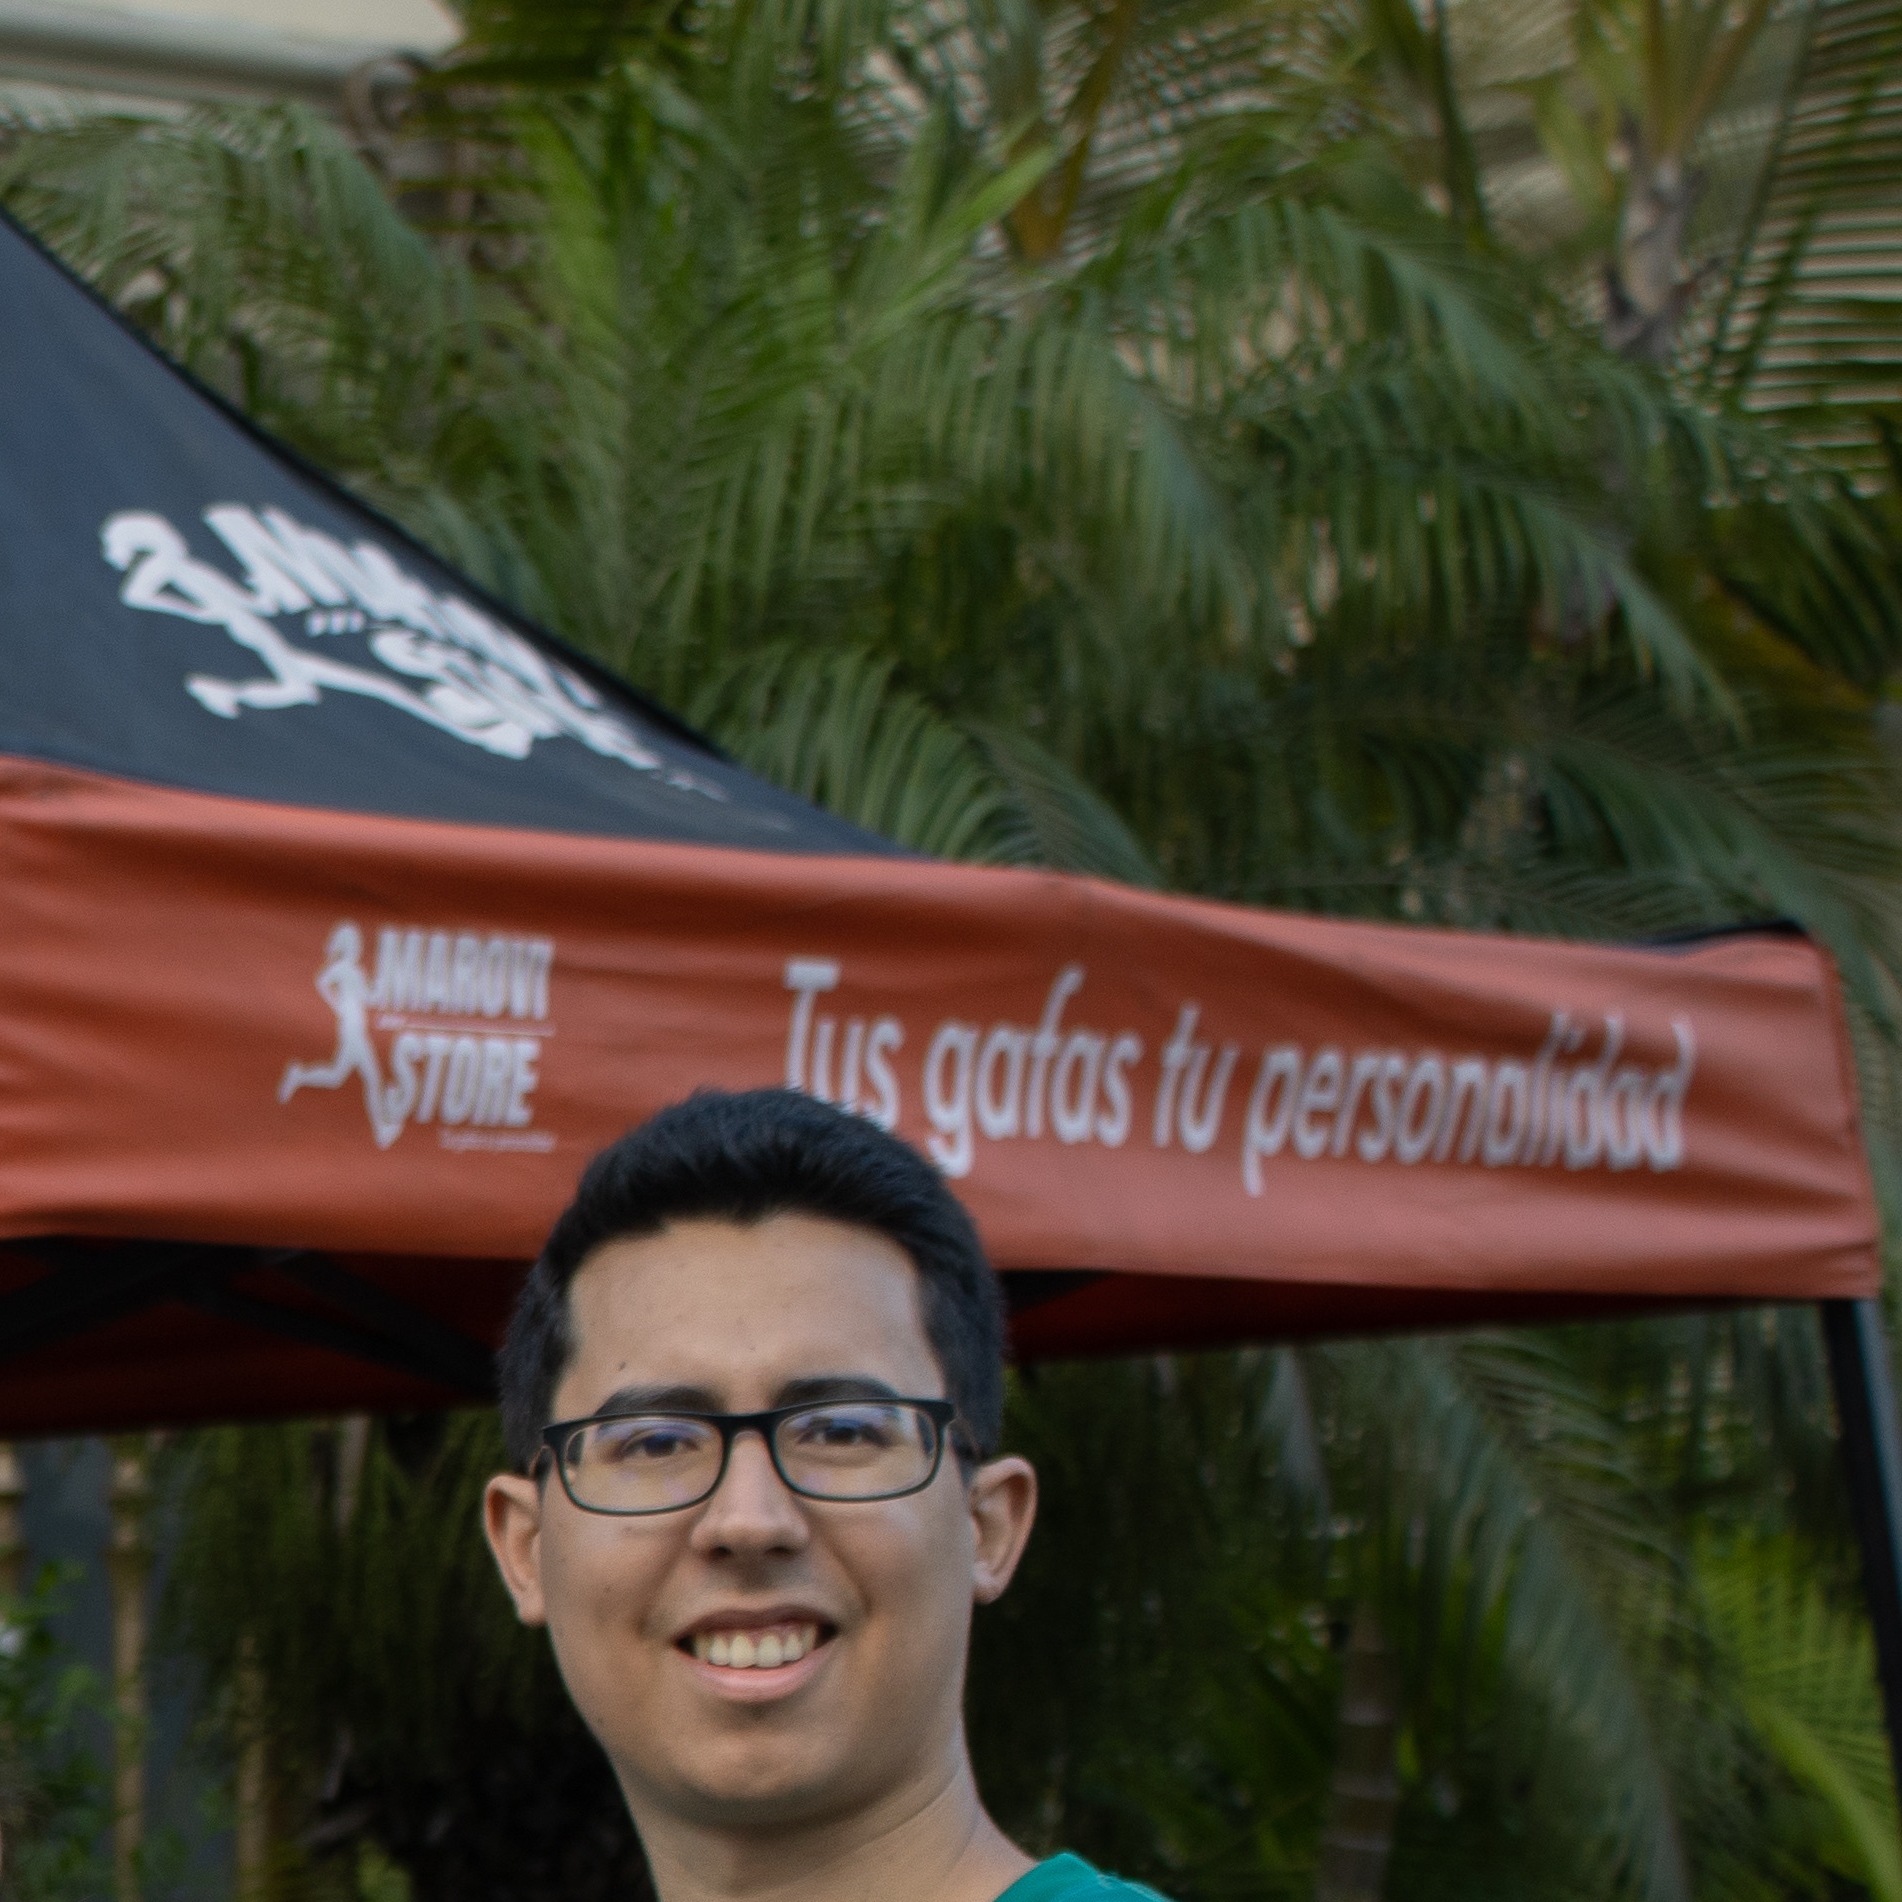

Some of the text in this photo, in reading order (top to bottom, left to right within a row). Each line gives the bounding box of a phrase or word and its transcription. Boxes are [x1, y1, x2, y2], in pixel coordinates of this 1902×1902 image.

[387, 1031, 540, 1126] STORE
[783, 956, 1694, 1197] Tus gafas tu personalidad
